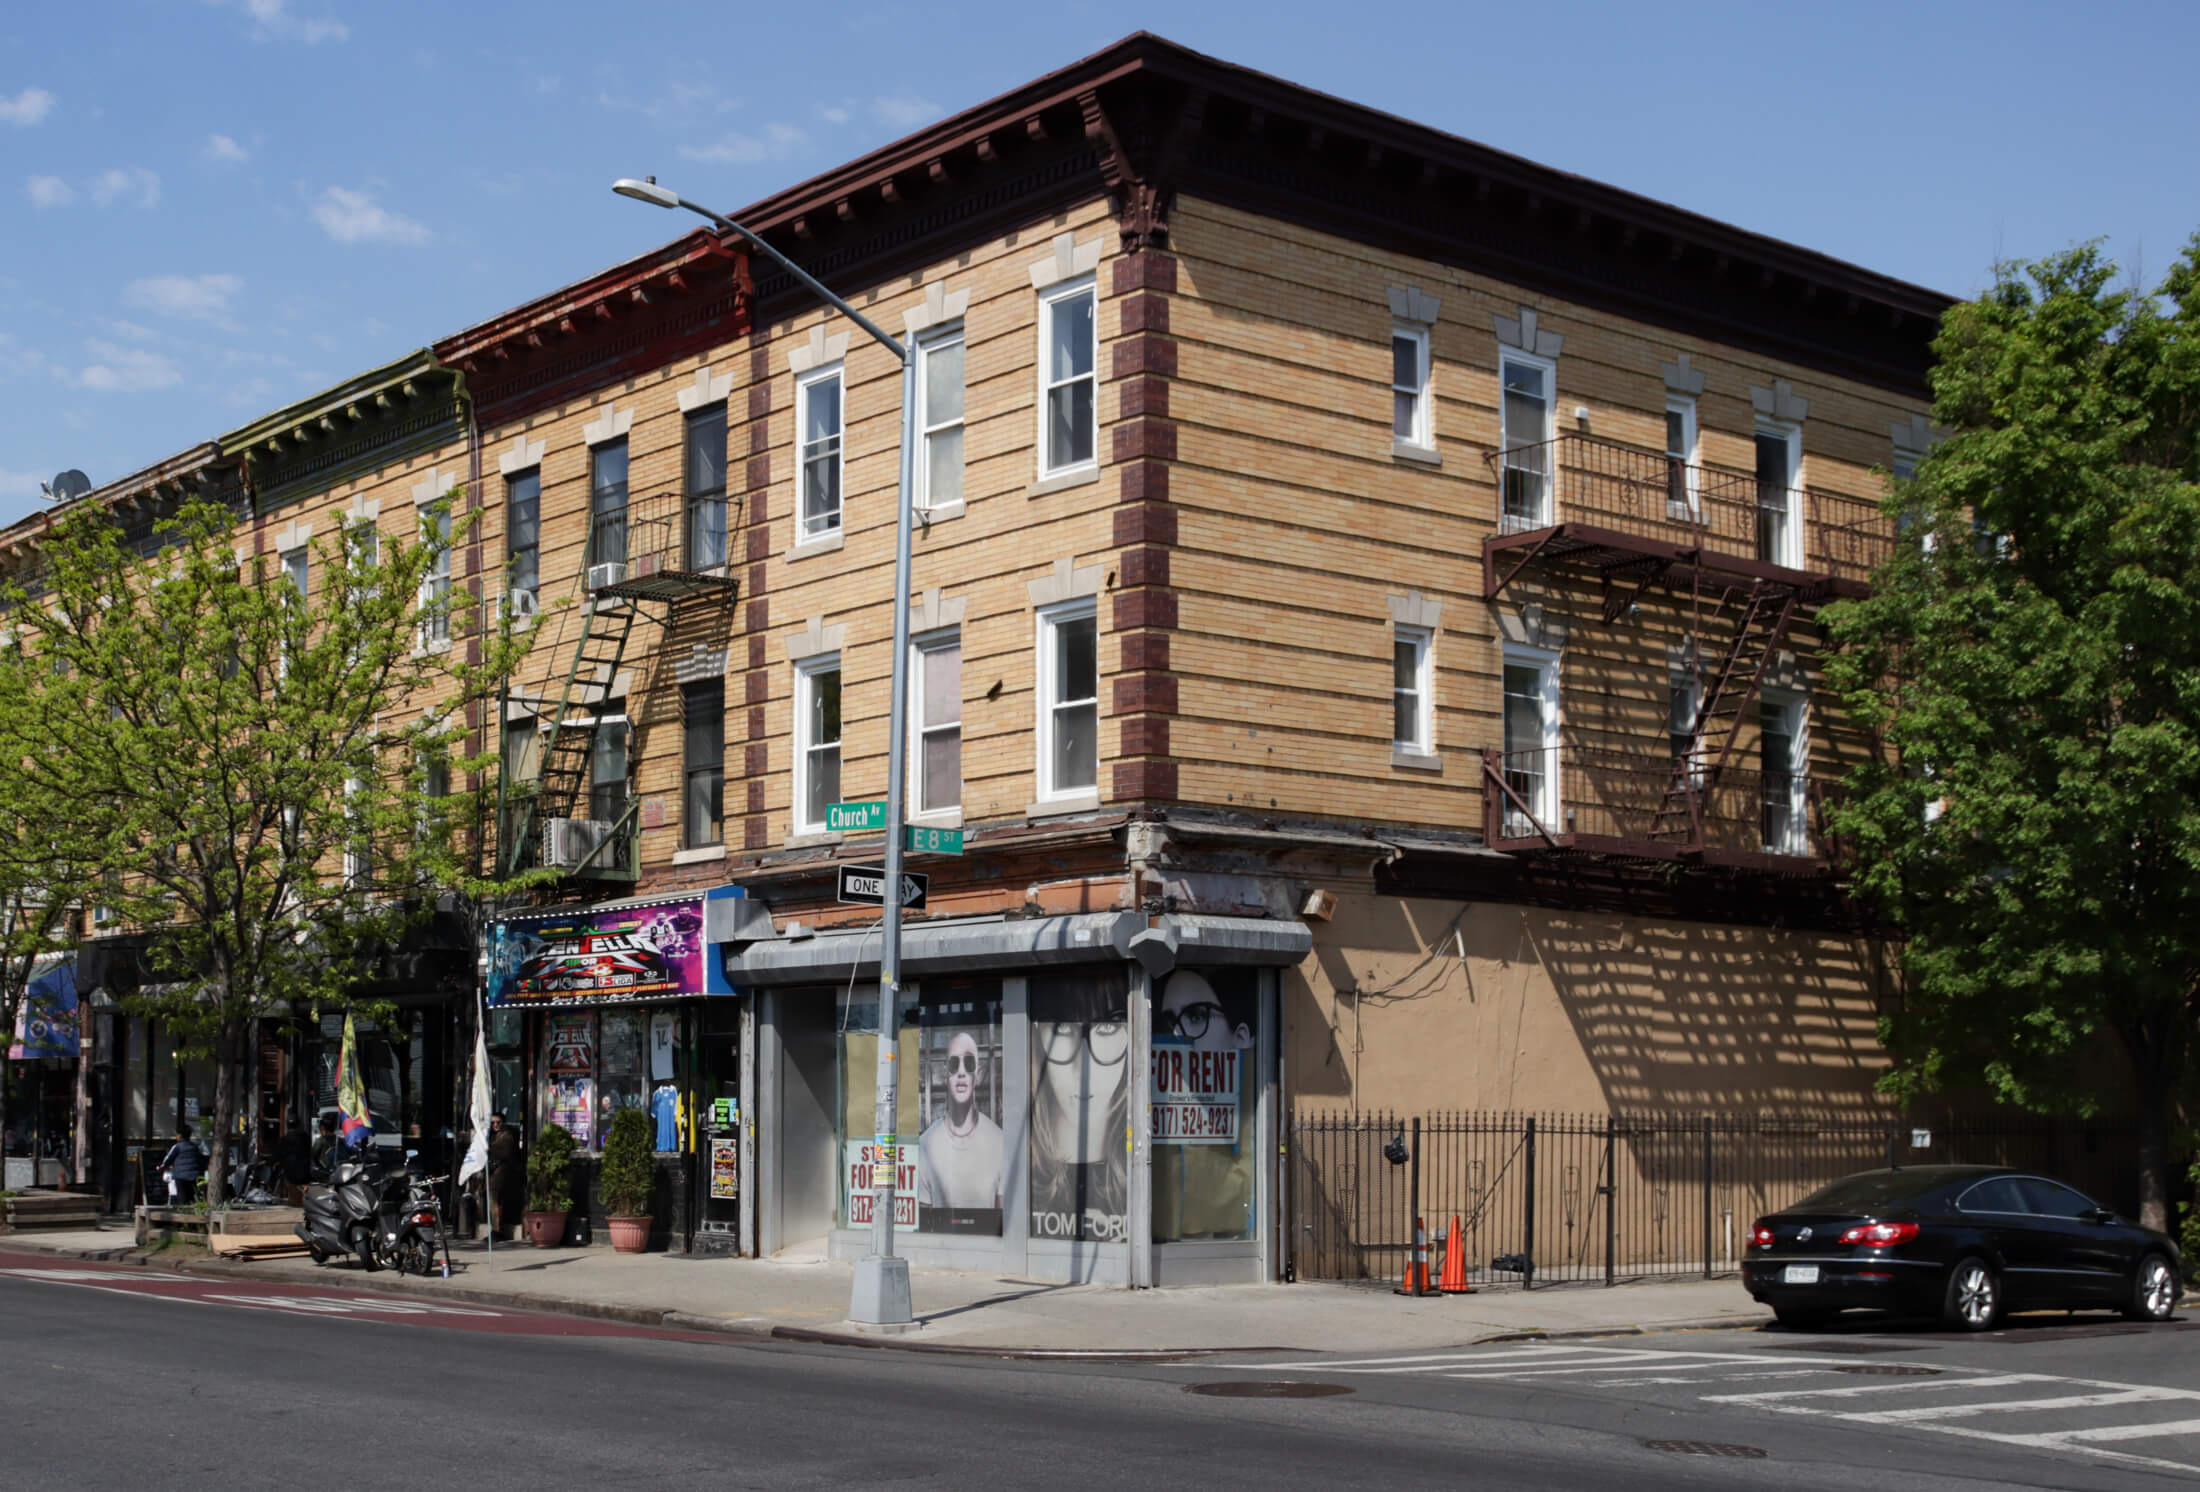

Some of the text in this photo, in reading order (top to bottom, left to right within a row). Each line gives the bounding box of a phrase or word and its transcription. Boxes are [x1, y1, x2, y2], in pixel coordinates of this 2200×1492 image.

[830, 804, 880, 827] Church Av
[913, 829, 955, 850] E 8 ST
[853, 878, 880, 894] ONE
[1189, 1050, 1236, 1094] RENT
[1181, 1107, 1235, 1136] 524-9231
[1032, 1211, 1077, 1236] TOM
